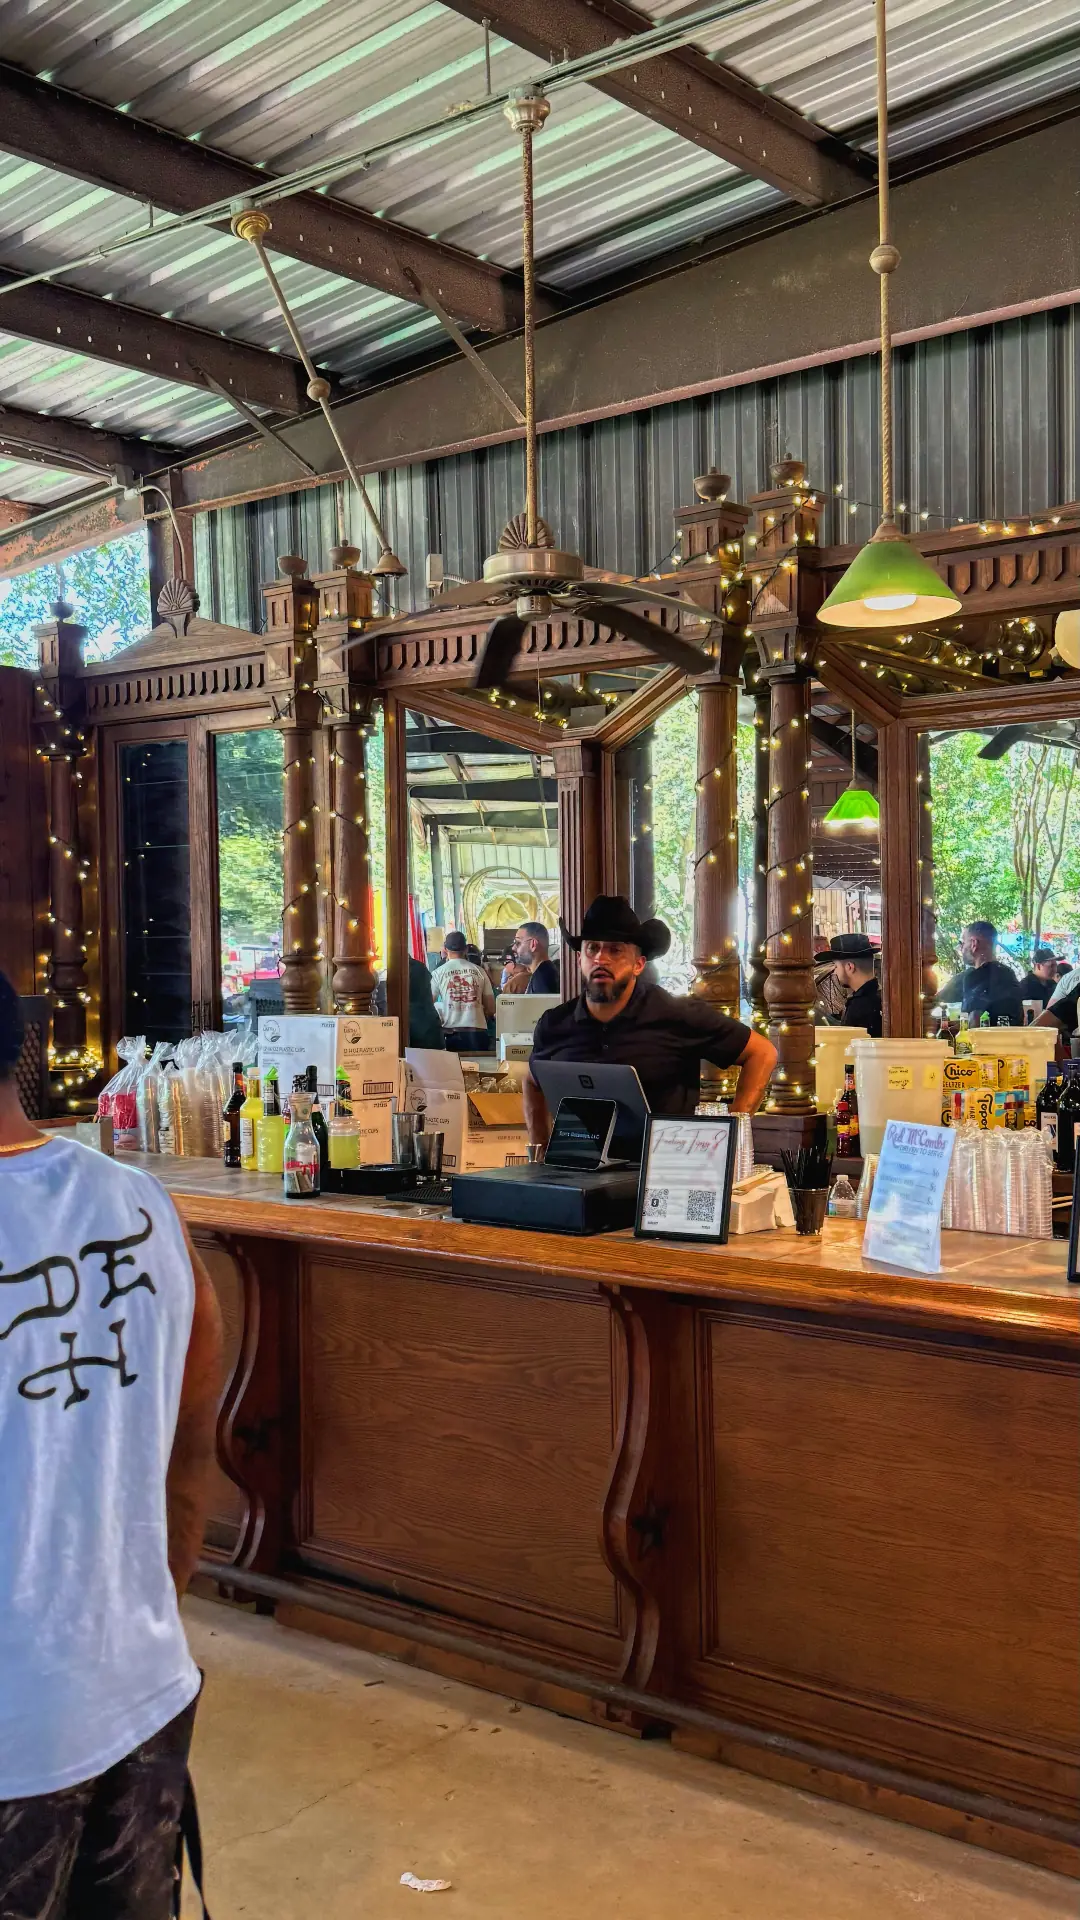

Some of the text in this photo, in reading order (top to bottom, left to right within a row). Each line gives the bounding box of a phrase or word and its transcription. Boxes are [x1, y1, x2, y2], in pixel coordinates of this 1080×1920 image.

[944, 1063, 976, 1080] Chico
[887, 1125, 949, 1150] Red McCombs
[900, 1145, 919, 1154] DRIVEN
[928, 1150, 945, 1158] SERVE
